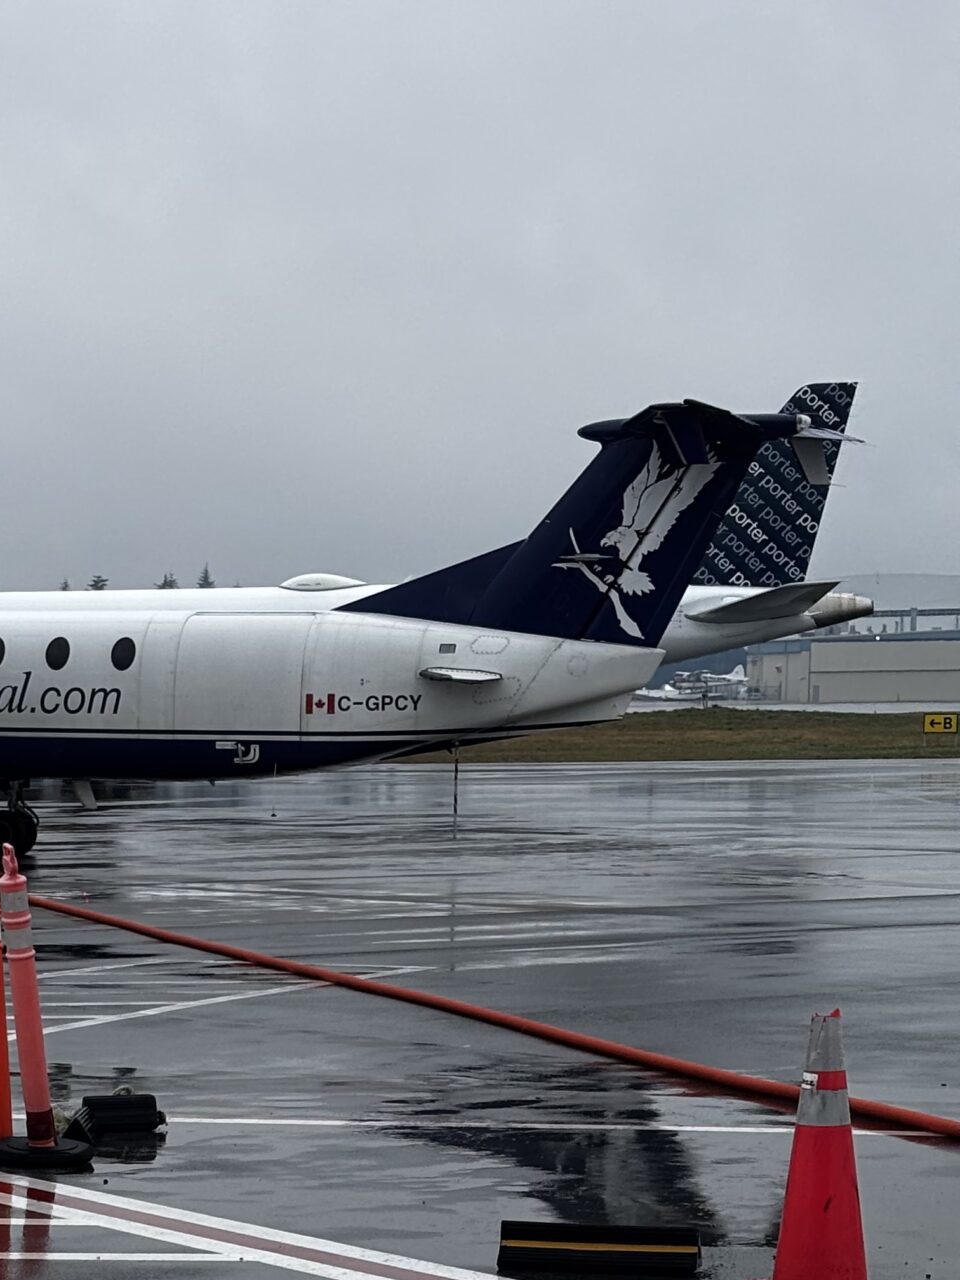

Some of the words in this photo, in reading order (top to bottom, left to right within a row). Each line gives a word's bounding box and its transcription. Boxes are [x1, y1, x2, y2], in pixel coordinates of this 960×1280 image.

[795, 386, 841, 426] porter
[757, 441, 802, 482] porter
[758, 474, 803, 515] porter
[724, 503, 769, 544] porter
[758, 506, 803, 547] porter
[721, 532, 767, 573] porter
[337, 694, 422, 712] C-GPCY
[943, 717, 952, 729] B
